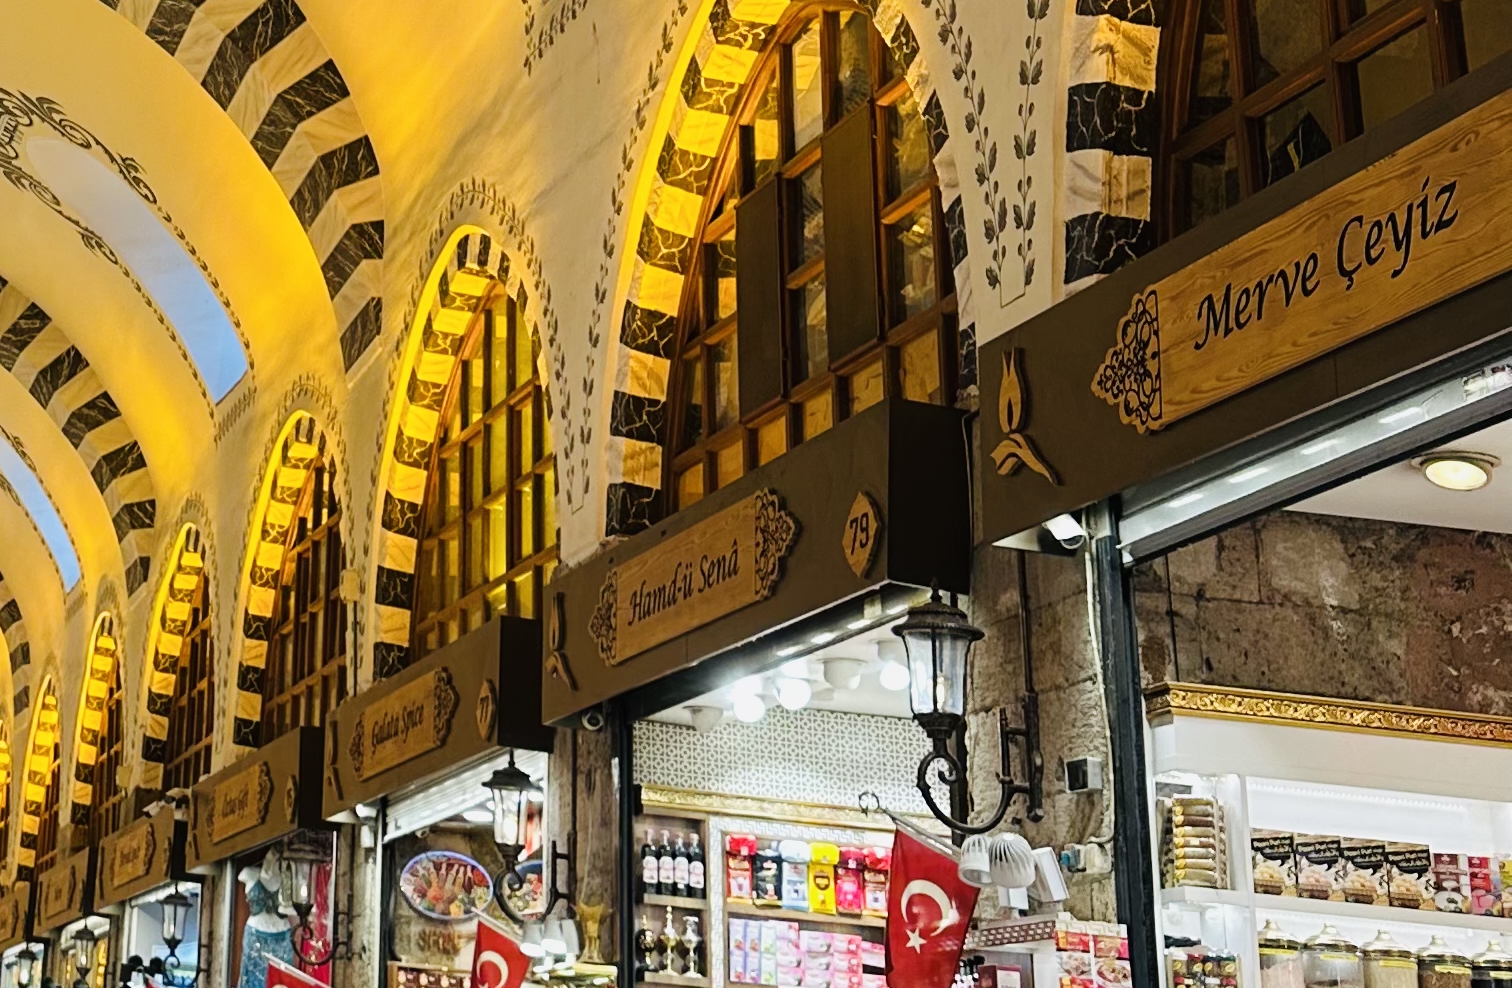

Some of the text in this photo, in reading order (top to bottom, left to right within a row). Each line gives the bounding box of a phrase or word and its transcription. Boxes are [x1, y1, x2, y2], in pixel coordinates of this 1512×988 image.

[1193, 175, 1459, 351] Merve Çeyiz
[849, 512, 870, 556] 79
[627, 537, 741, 627] Hamd-ü Senâ
[371, 701, 425, 755] Galata Spice
